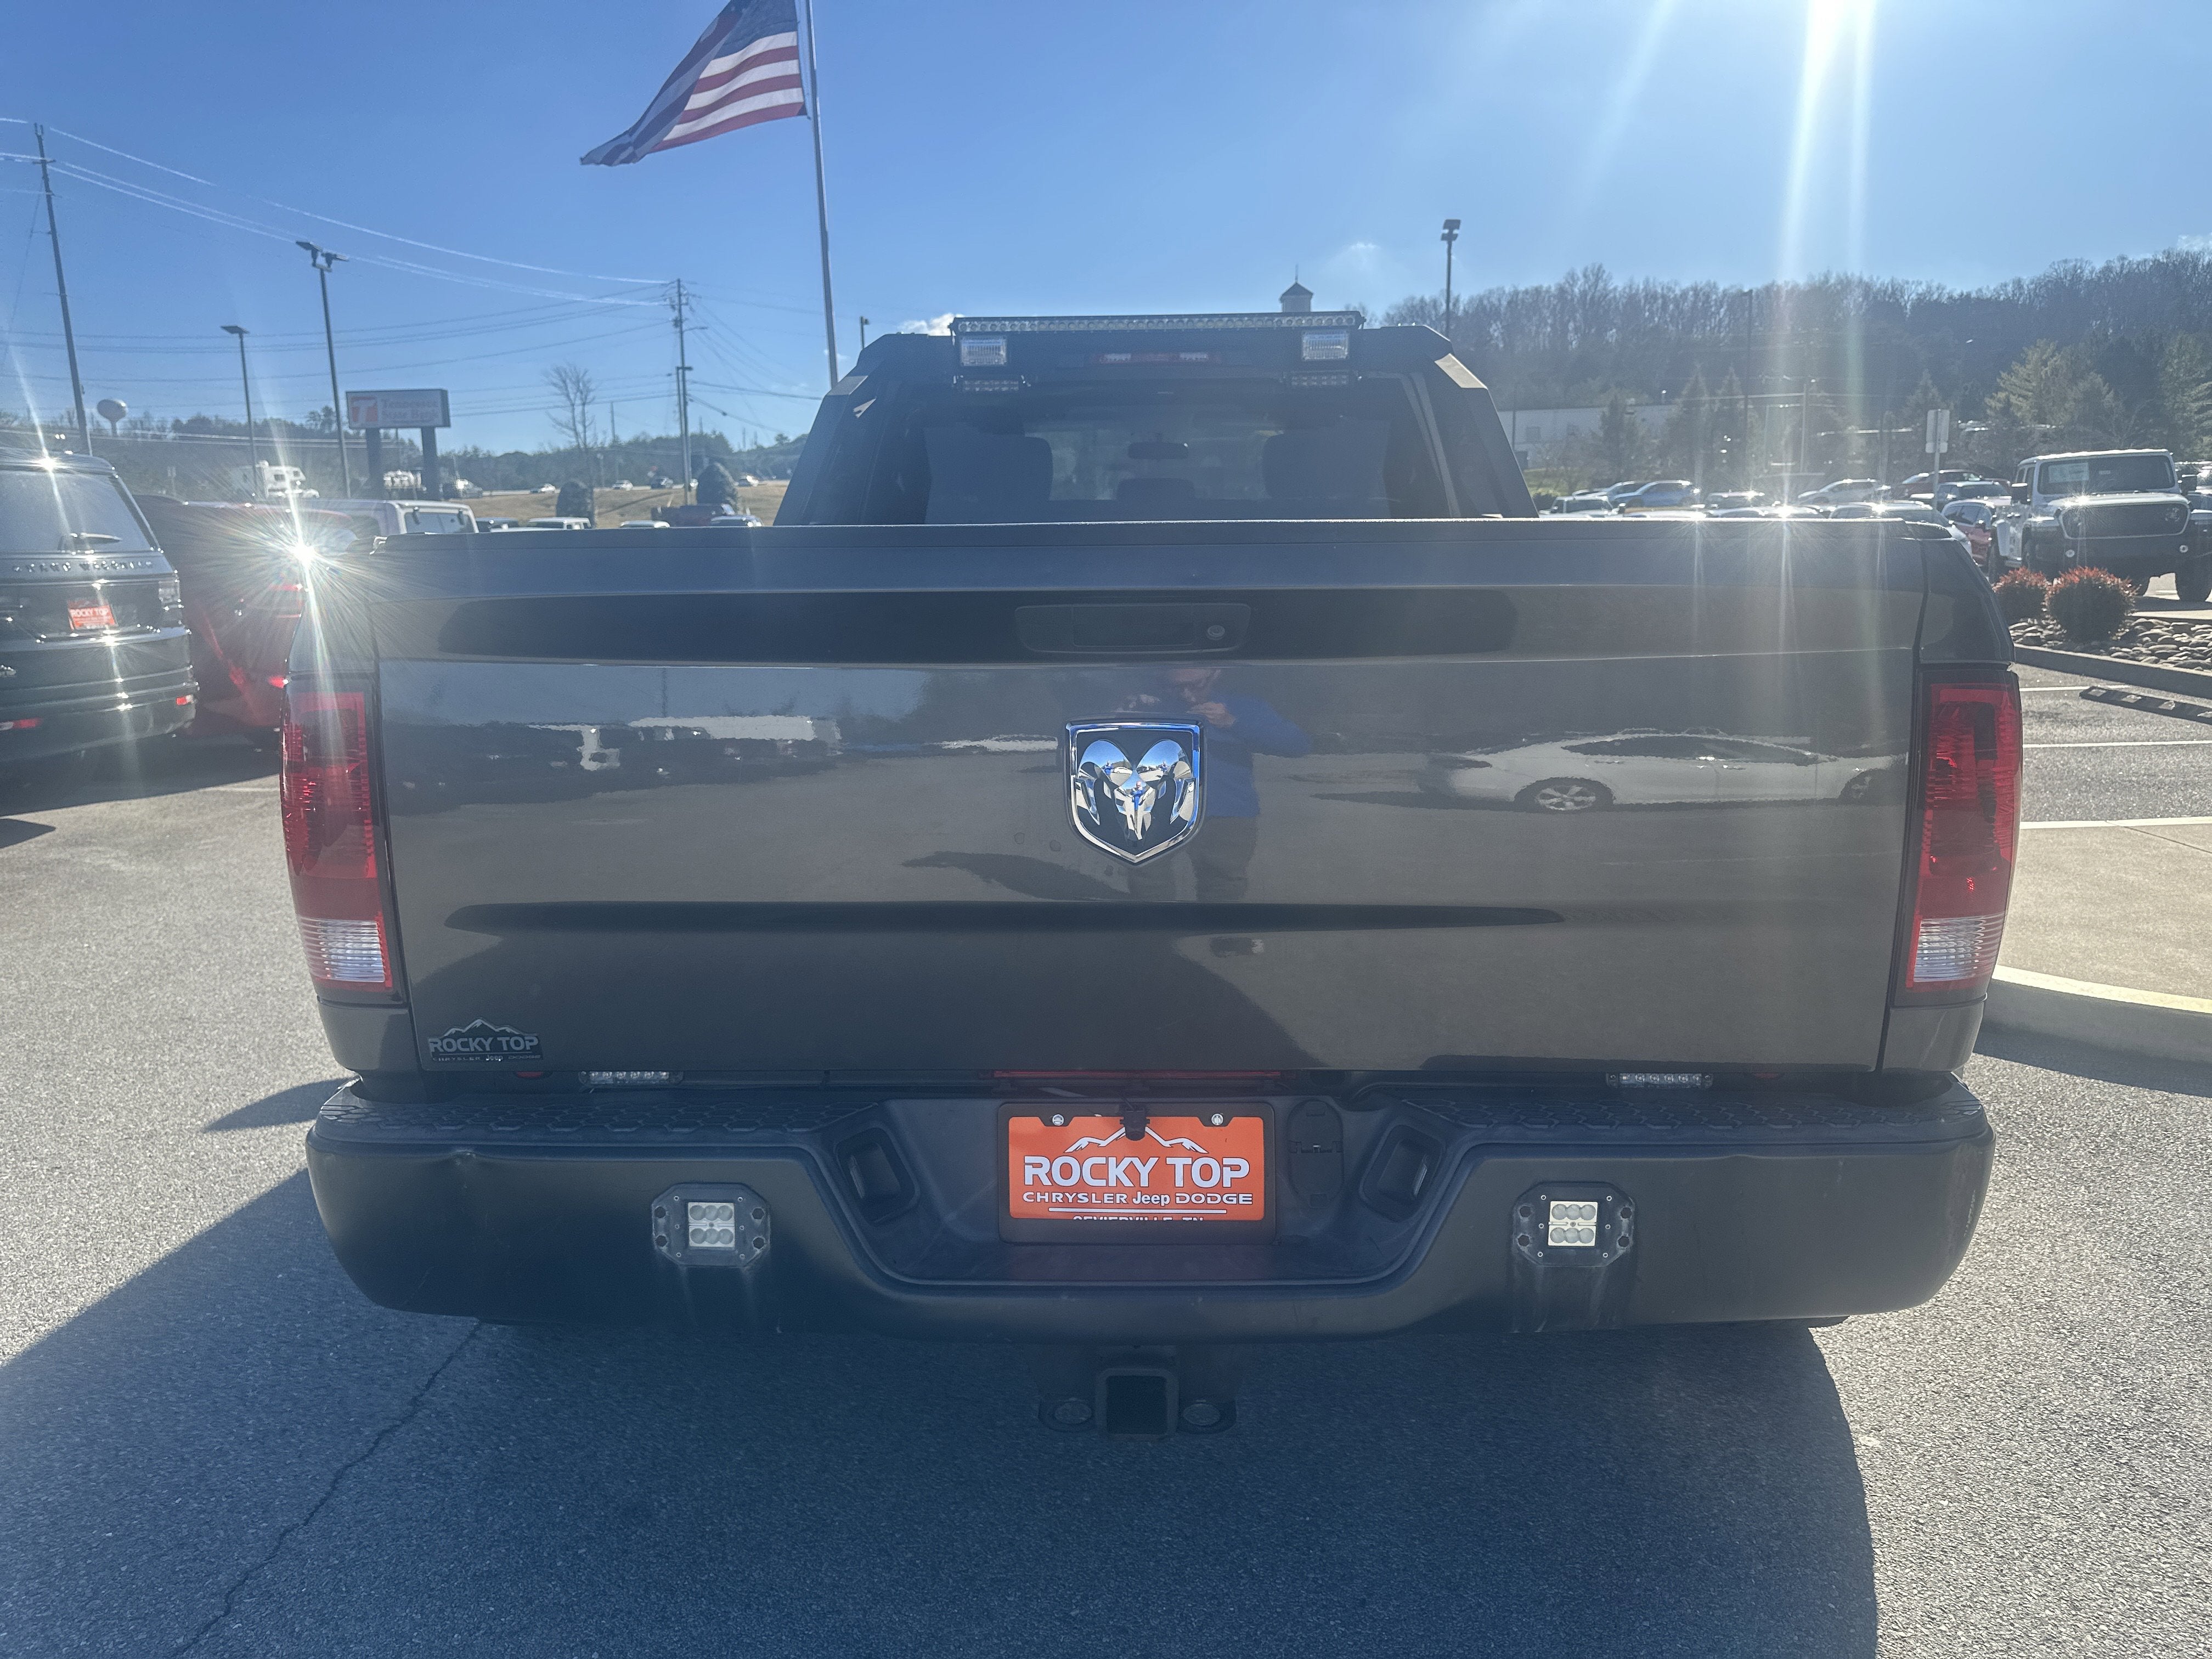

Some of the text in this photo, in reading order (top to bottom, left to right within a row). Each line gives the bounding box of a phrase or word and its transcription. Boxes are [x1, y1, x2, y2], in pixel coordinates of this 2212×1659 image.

[428, 1036, 539, 1052] ROCKY TOP
[1024, 1155, 1250, 1188] ROCKY TOP
[1022, 1191, 1253, 1206] CHRYSLER Jeep DODGE
